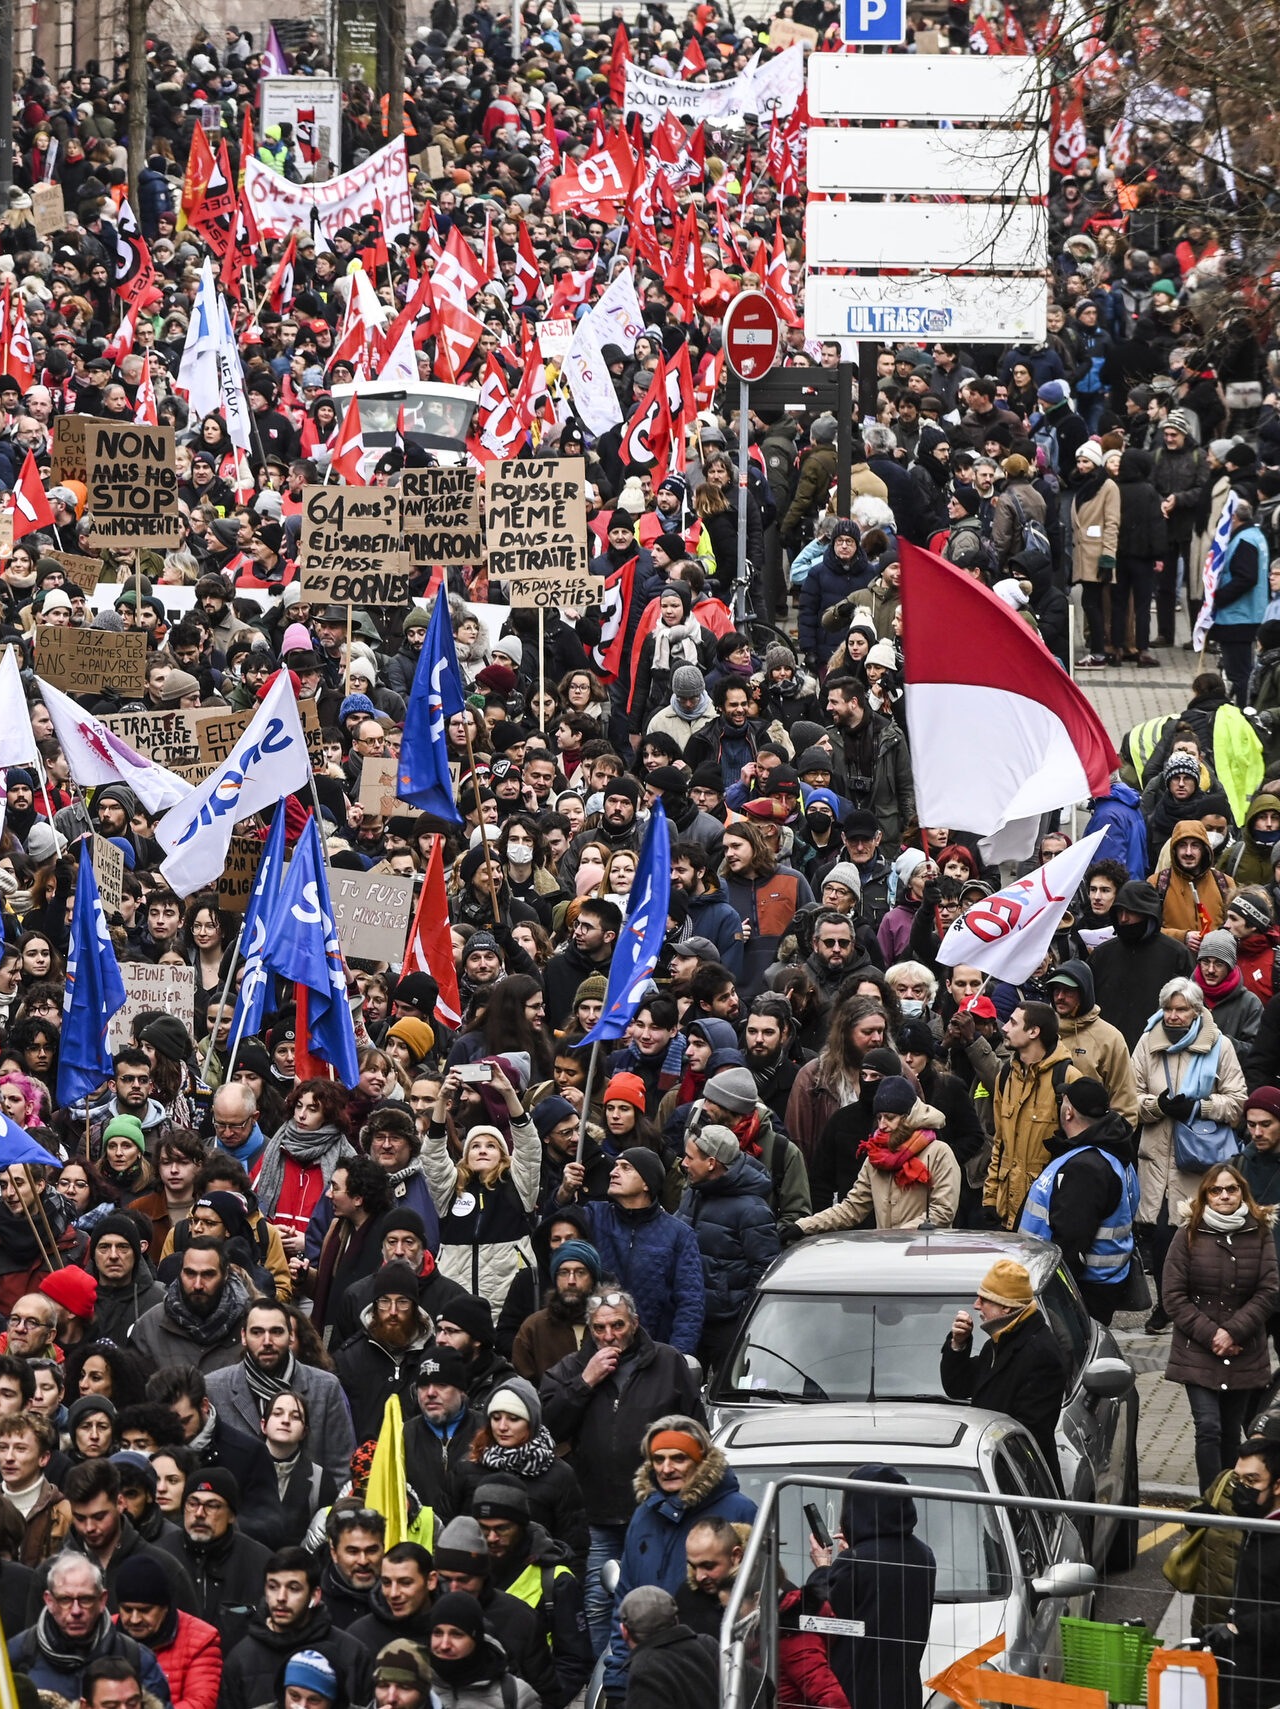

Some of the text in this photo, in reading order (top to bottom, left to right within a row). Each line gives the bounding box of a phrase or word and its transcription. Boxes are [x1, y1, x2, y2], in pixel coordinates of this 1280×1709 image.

[860, 0, 887, 31] P
[541, 322, 570, 337] AESH
[850, 308, 920, 332] ULTRAS
[221, 355, 240, 417] METAUX
[96, 430, 165, 462] NON
[92, 464, 138, 483] MAIS
[501, 461, 559, 479] FAUT
[93, 485, 174, 513] STOP
[491, 483, 578, 501] POUSSER
[308, 492, 344, 531] 64
[403, 493, 473, 515] ANTICIPÉE
[425, 513, 468, 527] POUR
[489, 501, 566, 529] MÉMÉ
[100, 523, 112, 536] UN
[499, 532, 574, 547] DANS LA
[309, 528, 399, 553] ÉLISABETH
[403, 533, 481, 561] MACRON
[306, 553, 383, 571] DÉPASSE
[304, 574, 409, 602] LES BORNES
[512, 579, 586, 596] PAS DANS LES
[40, 629, 62, 648] 64
[115, 635, 143, 648] DES
[76, 646, 143, 658] HOMMES LES
[35, 653, 66, 676] ANS
[71, 672, 142, 688] SONT MORTS
[366, 883, 407, 908] FUIS
[353, 907, 408, 929] MINISTRES
[128, 964, 194, 984] JEUNE POUR
